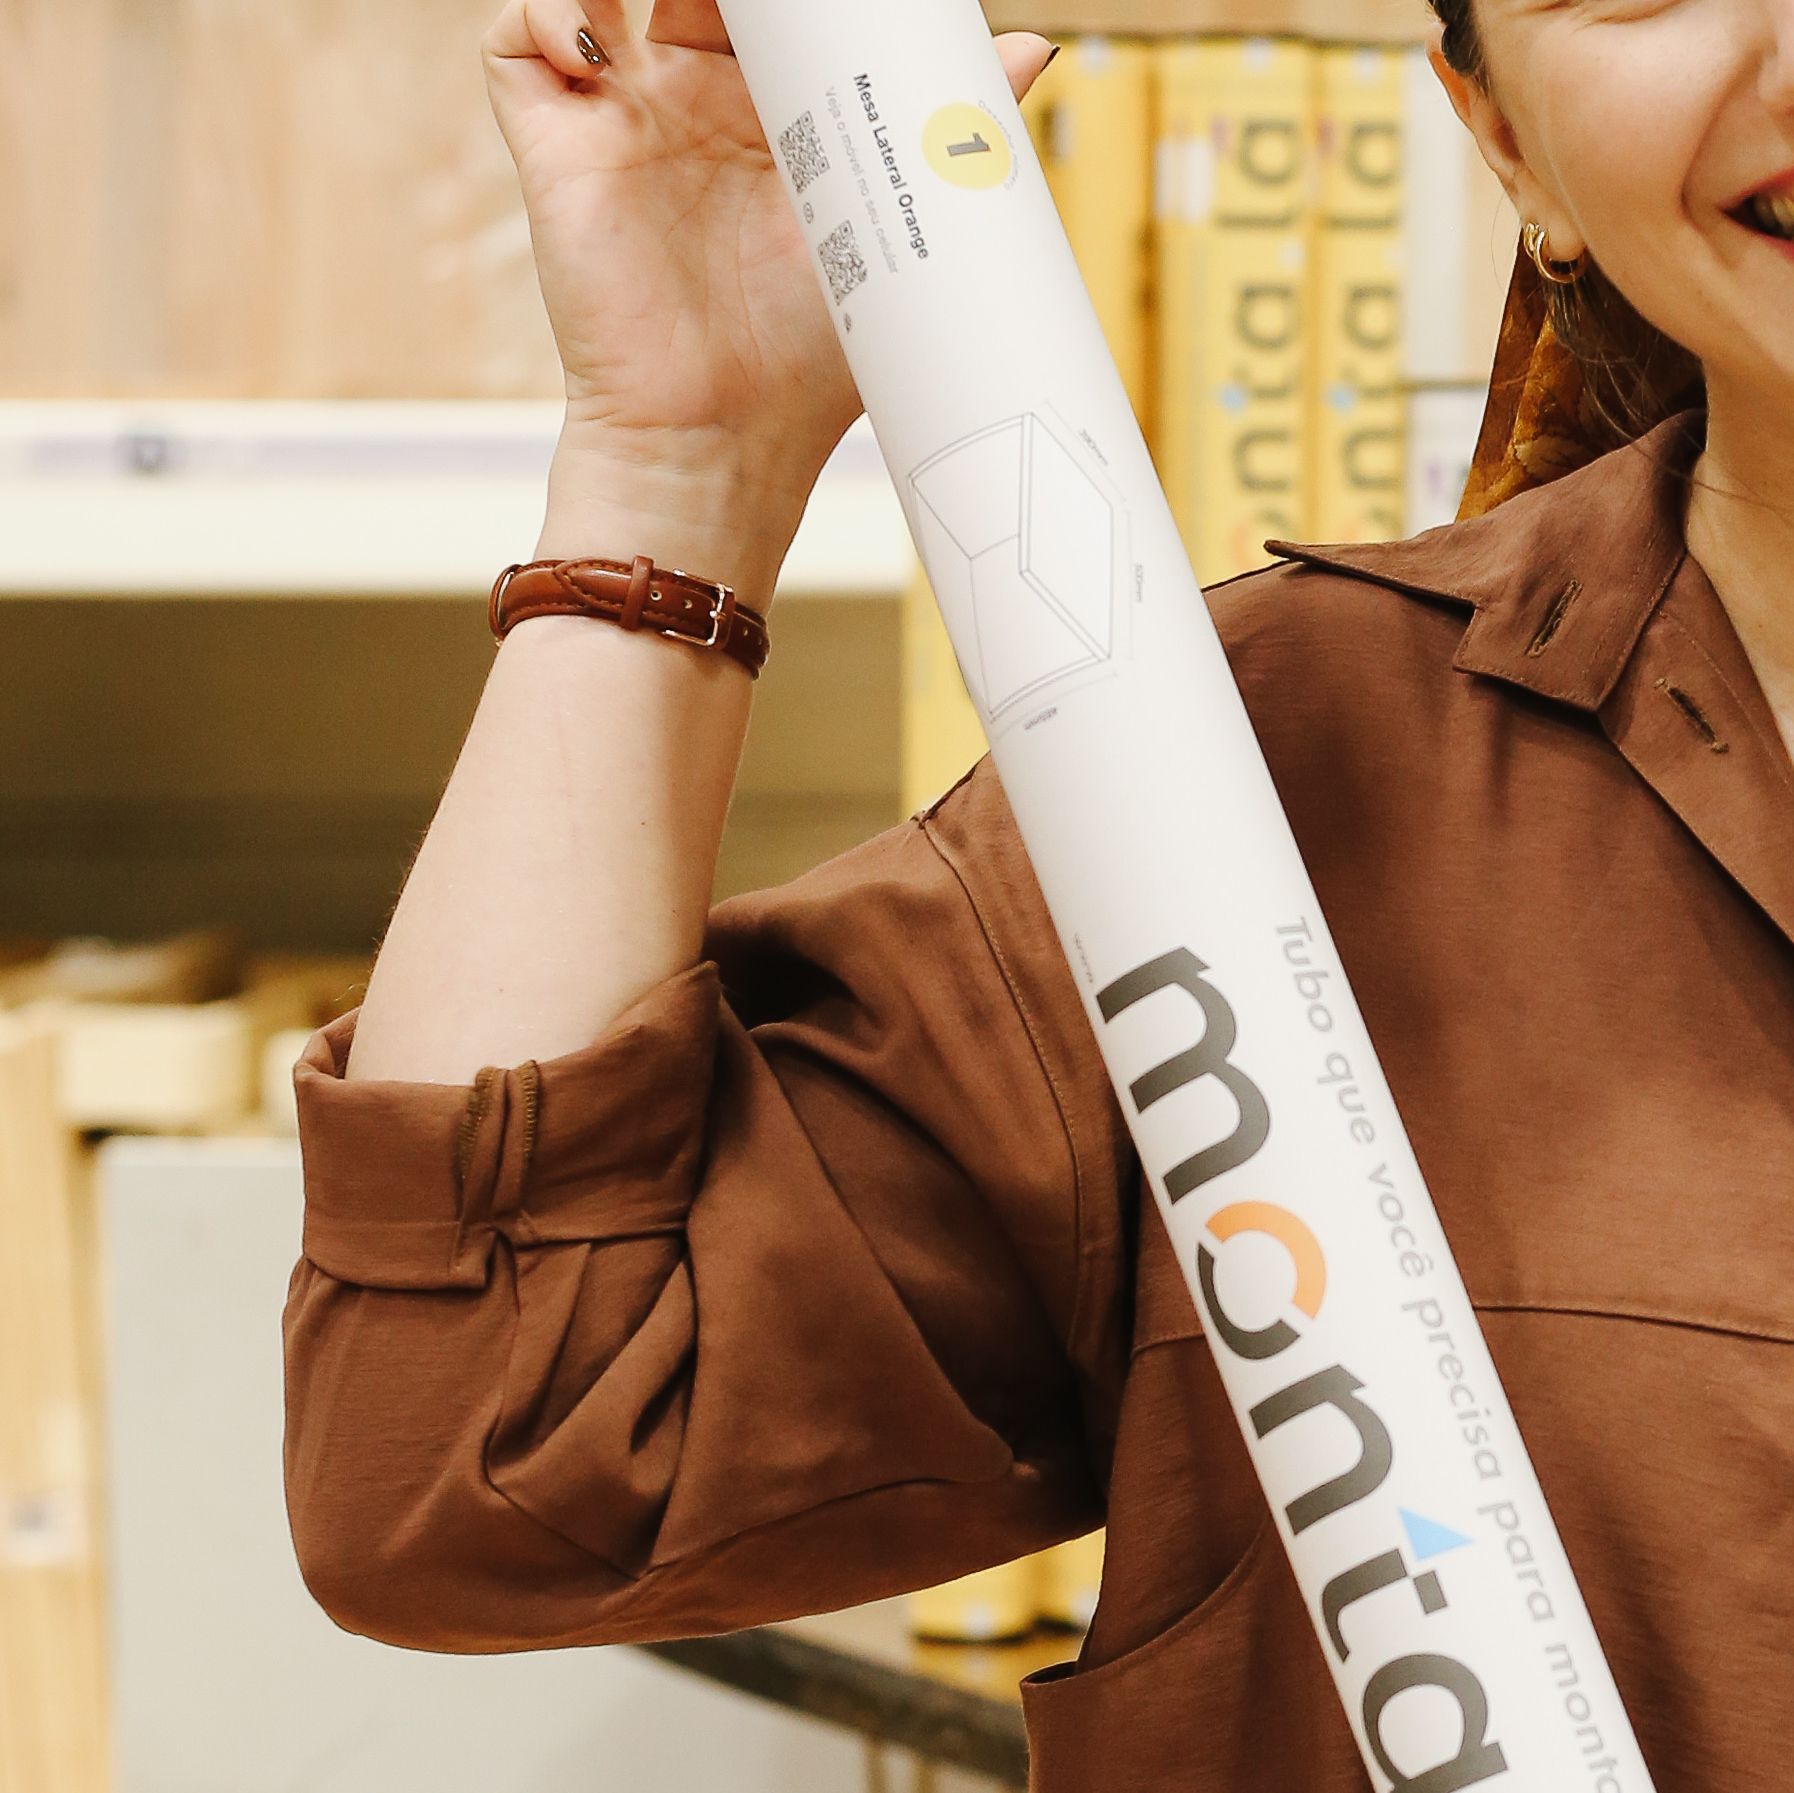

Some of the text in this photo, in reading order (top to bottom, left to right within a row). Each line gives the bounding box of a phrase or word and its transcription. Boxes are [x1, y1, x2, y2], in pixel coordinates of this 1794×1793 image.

[853, 72, 930, 260] Mesa Lateral Orange
[946, 131, 992, 158] 1
[1275, 915, 1333, 1033] Tubo
[1317, 1052, 1376, 1146] que
[1367, 1162, 1434, 1279] você
[1401, 1297, 1503, 1482] precisa
[1476, 1499, 1557, 1622] para
